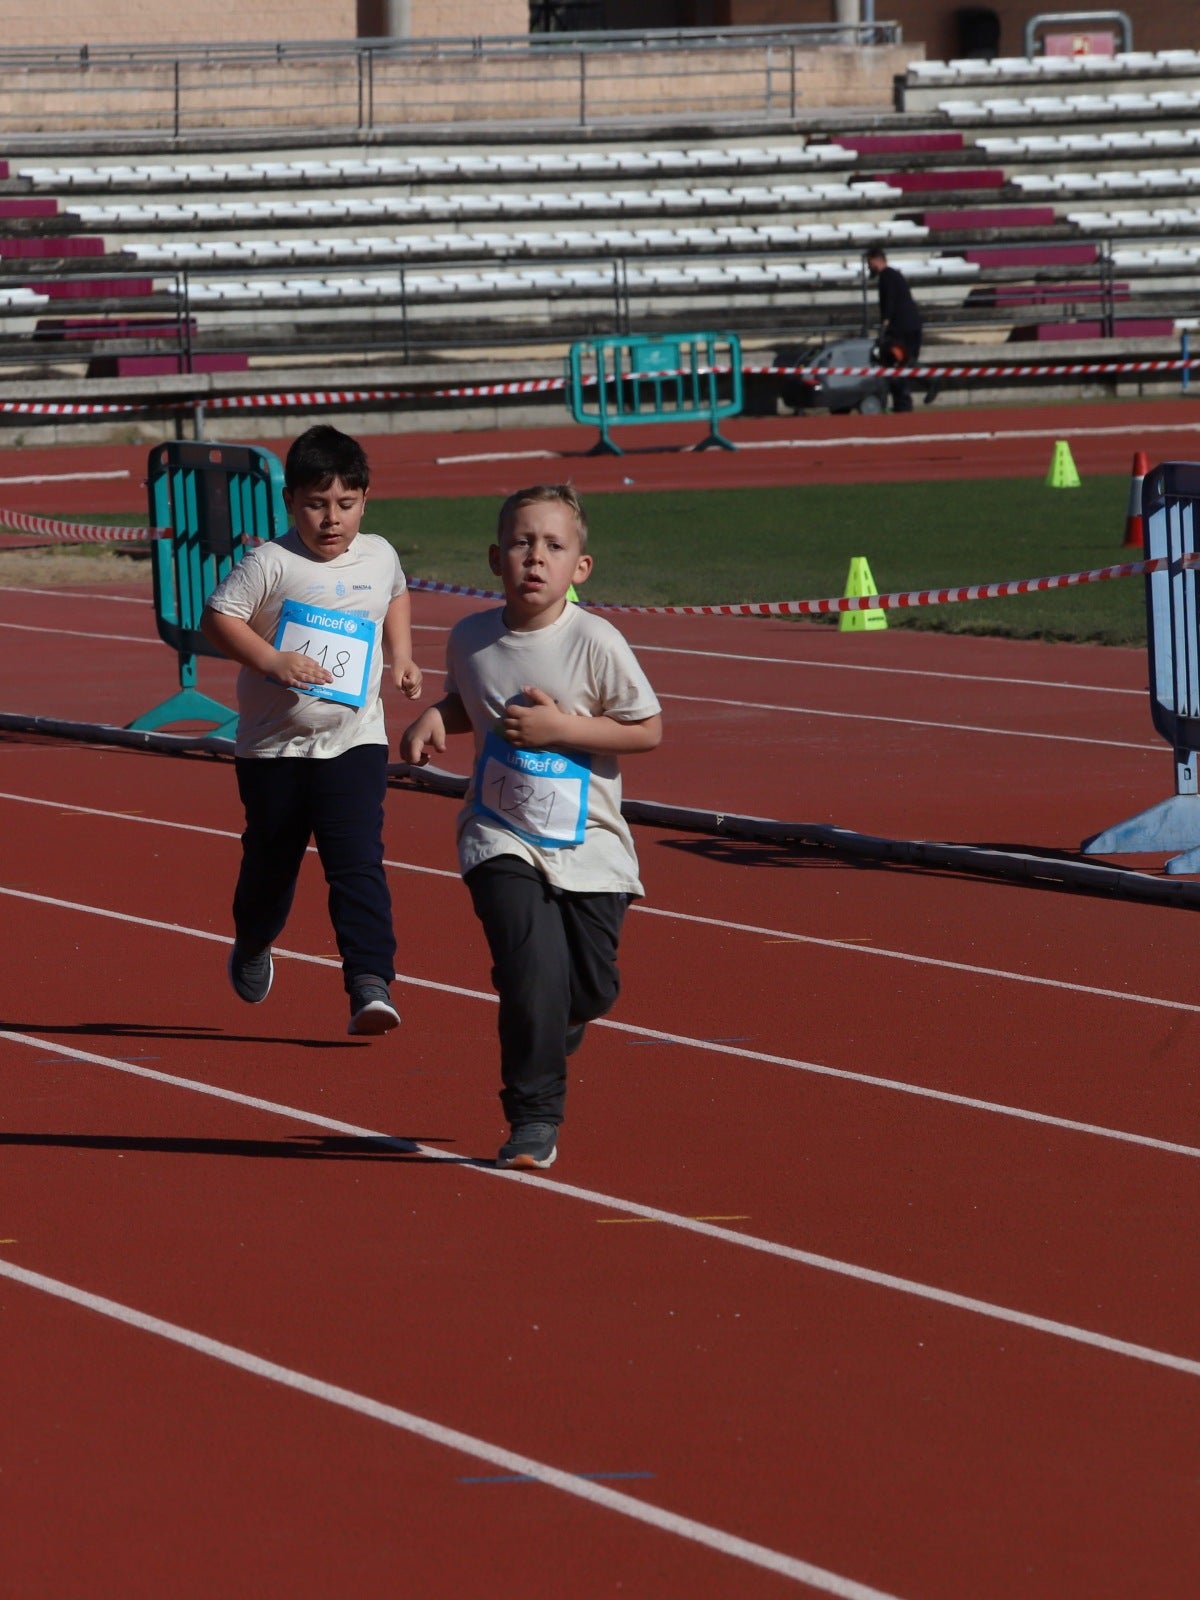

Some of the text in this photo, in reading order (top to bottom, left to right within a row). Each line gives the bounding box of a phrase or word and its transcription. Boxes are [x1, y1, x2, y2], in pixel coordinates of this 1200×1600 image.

[305, 611, 345, 632] unicef
[506, 752, 553, 774] unicef
[490, 775, 556, 829] 121
